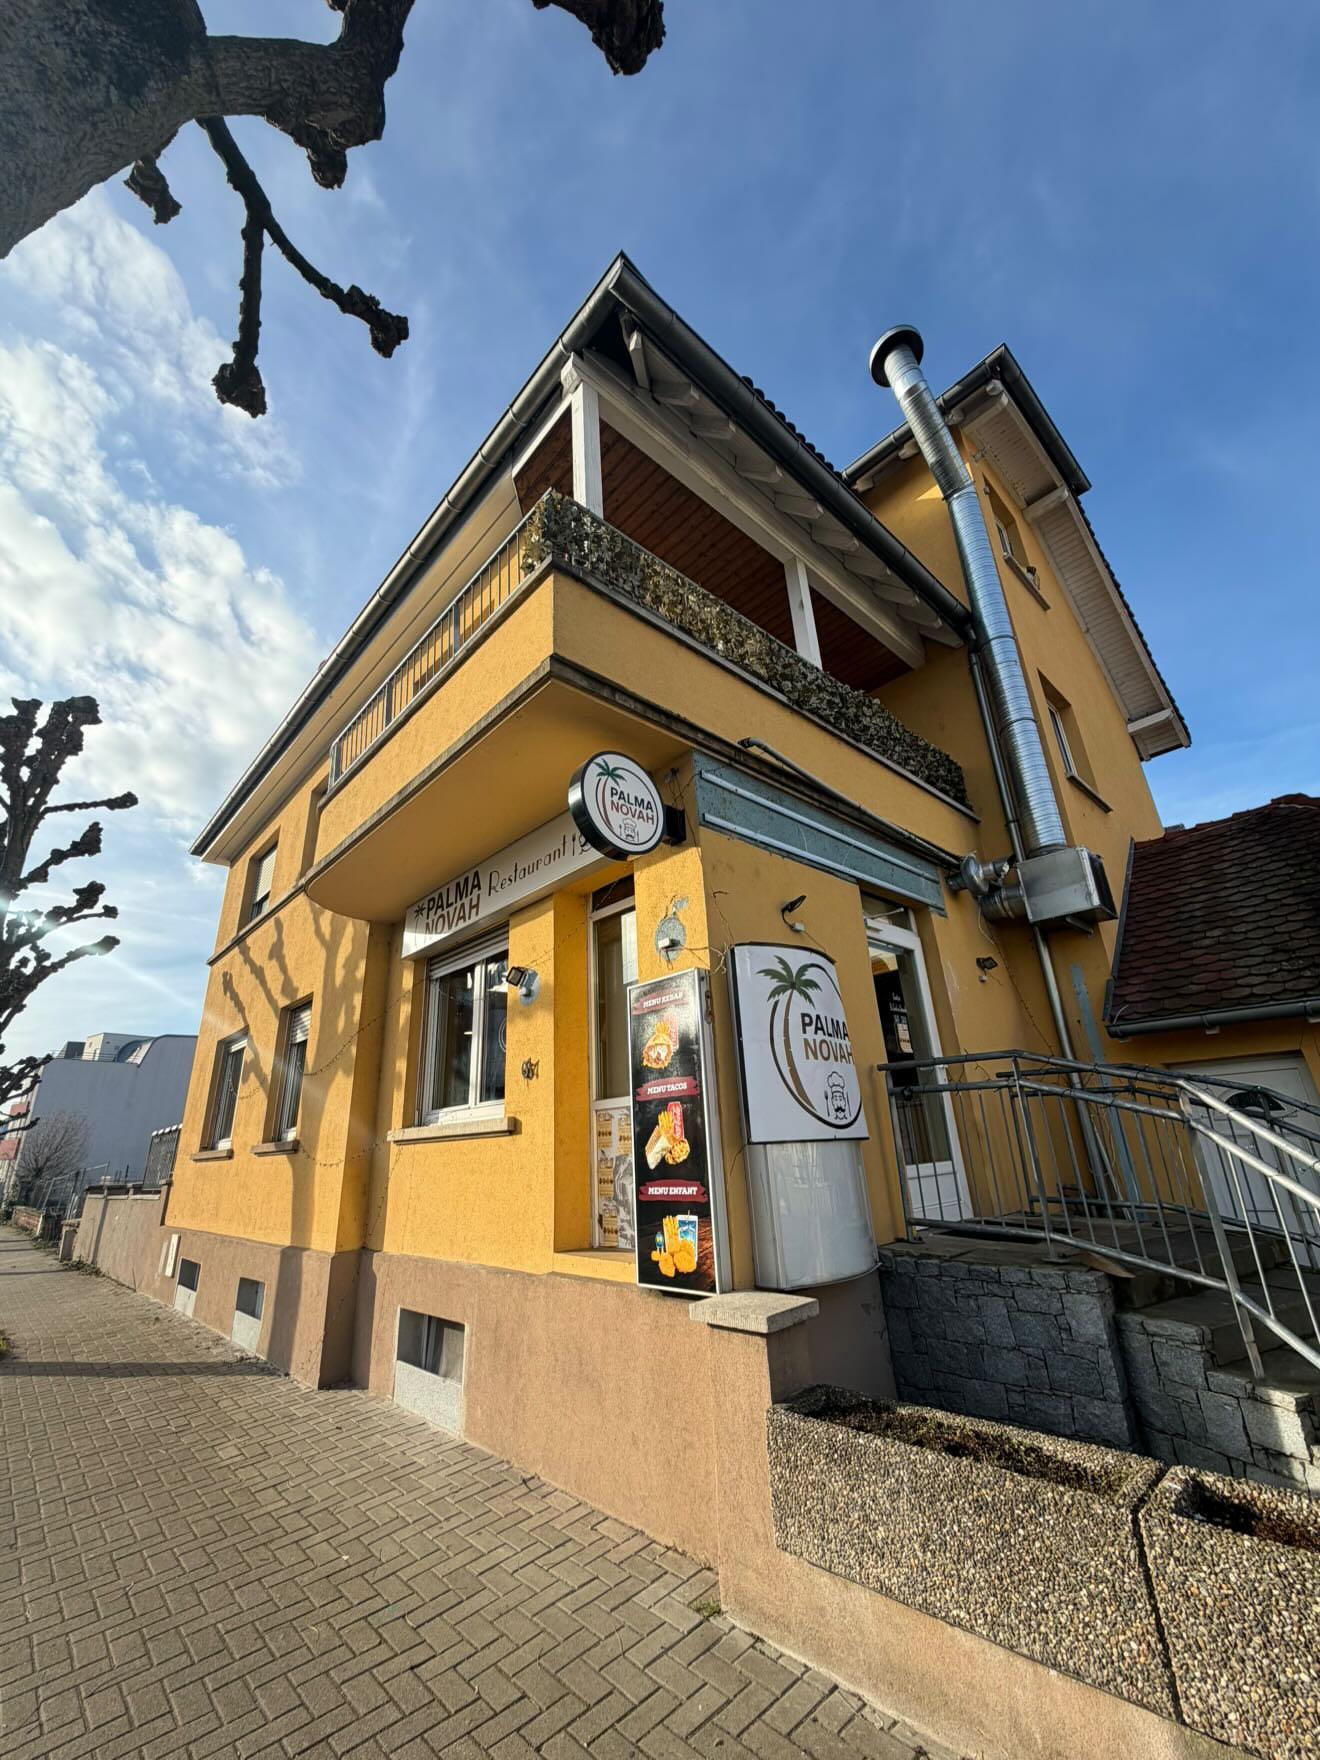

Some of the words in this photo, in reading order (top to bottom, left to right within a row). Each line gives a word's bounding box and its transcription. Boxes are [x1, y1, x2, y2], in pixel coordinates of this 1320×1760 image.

[610, 786, 654, 813] PALMA
[610, 799, 655, 825] NOVAH
[488, 834, 566, 896] Restaurant
[426, 870, 481, 920] PALMA
[424, 892, 481, 943] NOVAH
[643, 998, 662, 1008] MENU
[800, 1012, 850, 1041] PALMA
[803, 1037, 855, 1065] NOVAH
[647, 1085, 667, 1095] MENU
[667, 1082, 688, 1092] TACOS
[648, 1187, 668, 1195] MENU
[669, 1187, 698, 1195] ENFANT
